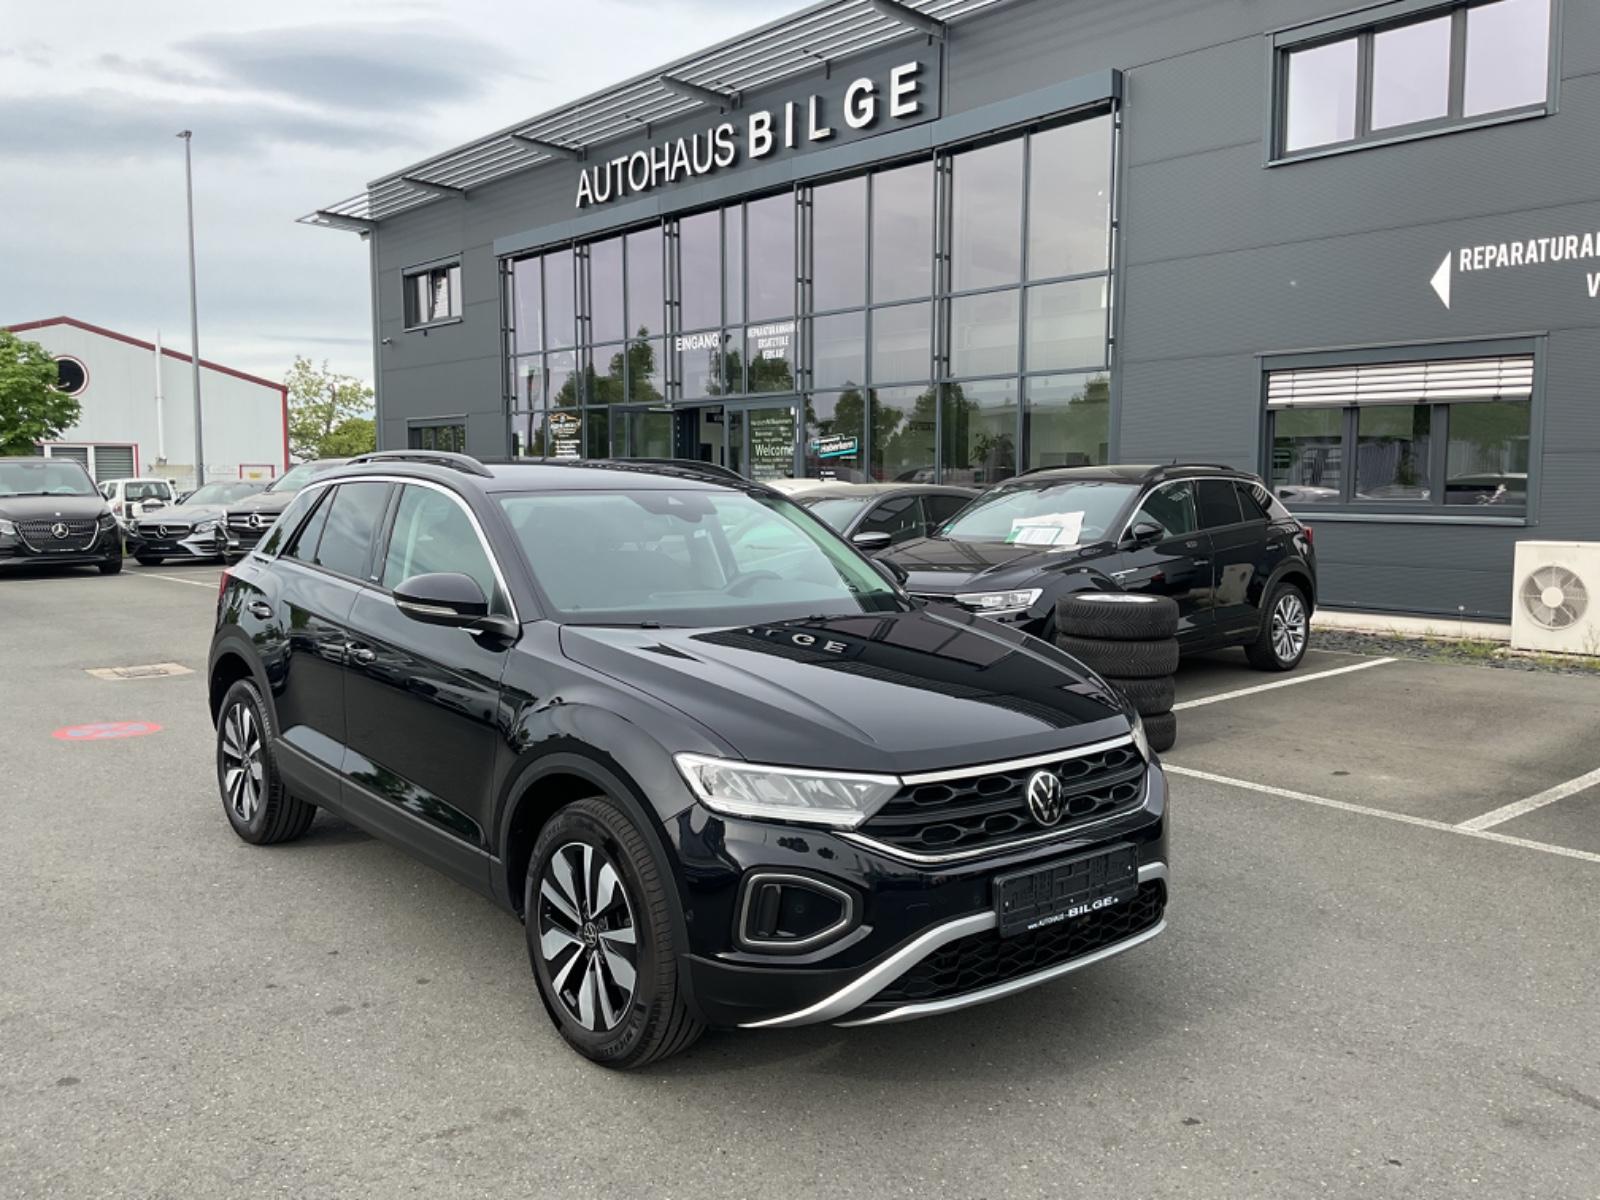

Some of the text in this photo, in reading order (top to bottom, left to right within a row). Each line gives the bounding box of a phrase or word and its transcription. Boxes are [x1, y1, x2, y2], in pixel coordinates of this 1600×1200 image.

[575, 61, 922, 208] AUTOHAUS BILGE
[1459, 231, 1600, 272] REPARATURA
[675, 333, 719, 351] EINGANG
[755, 444, 794, 457] Welcome
